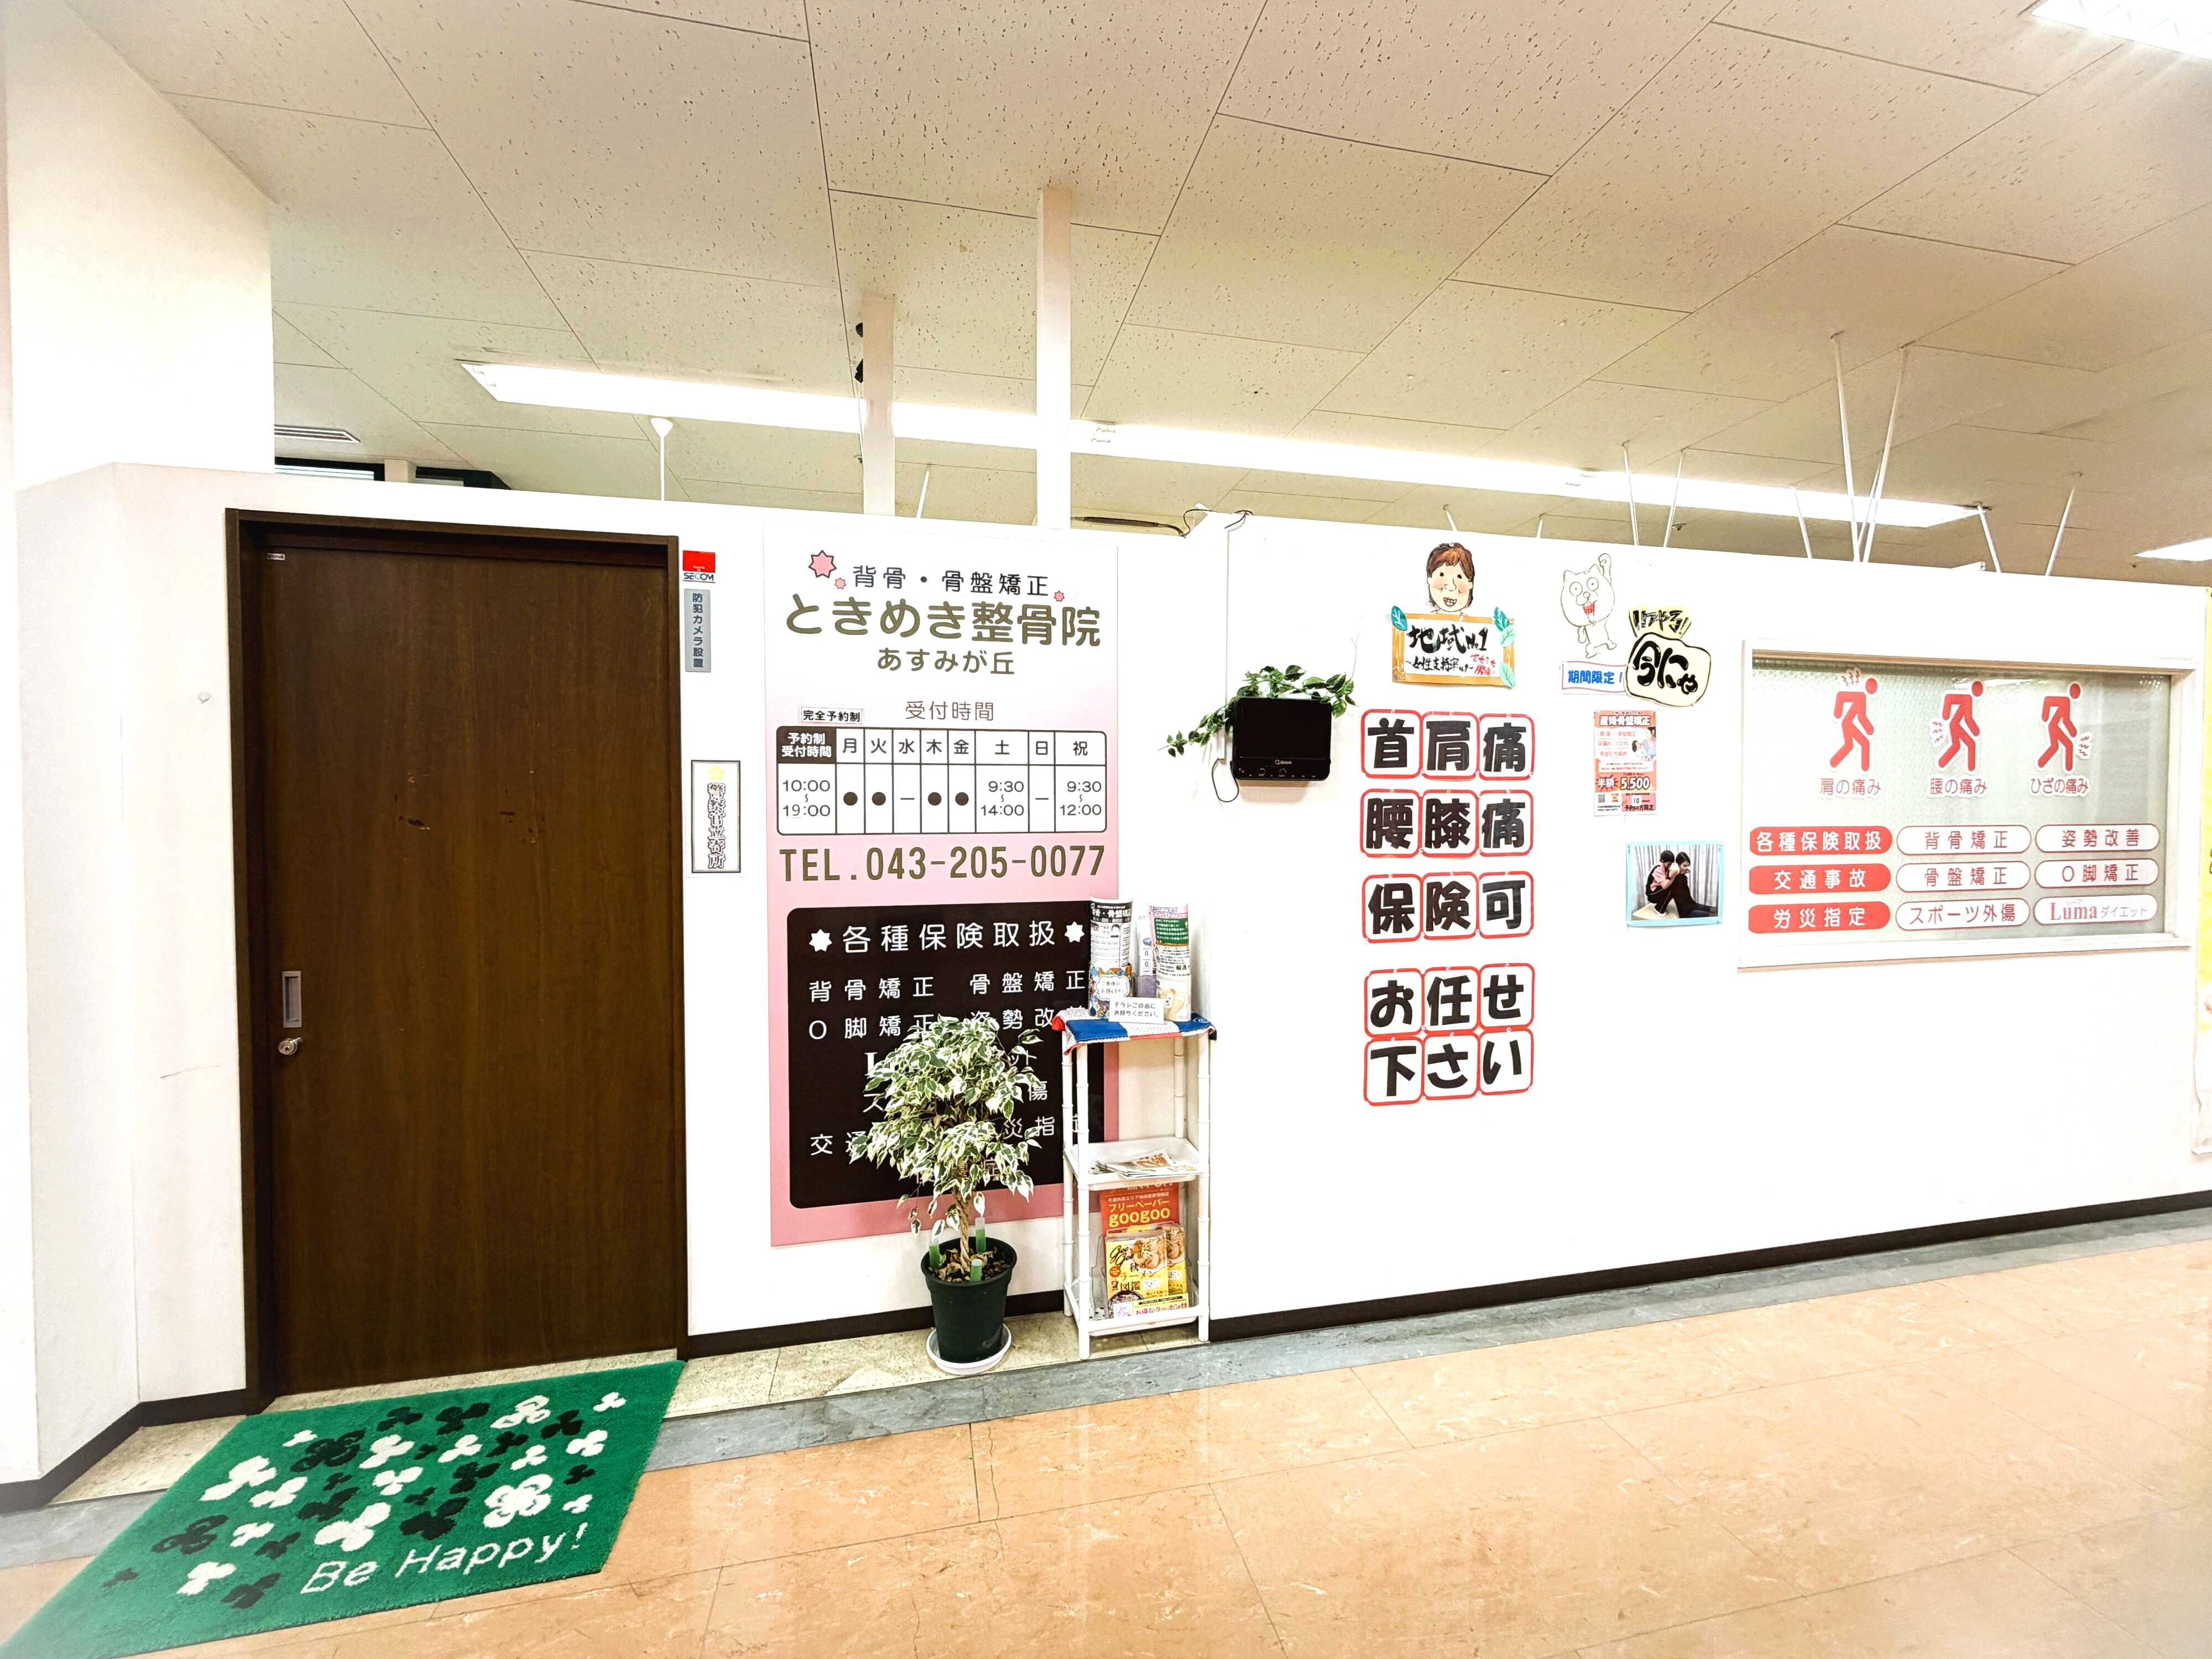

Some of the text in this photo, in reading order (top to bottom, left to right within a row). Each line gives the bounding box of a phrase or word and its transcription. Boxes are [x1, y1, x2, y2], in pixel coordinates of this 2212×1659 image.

[684, 572, 714, 581] SECOM
[852, 565, 1049, 597] 背骨・骨盤矯正
[786, 593, 1101, 647] ときめき整骨院
[692, 593, 704, 668] 防犯カメラ設置
[877, 647, 1015, 675] あすみが丘
[1567, 670, 1623, 685] 期間限定!
[803, 710, 860, 723] 完全予約制
[905, 701, 994, 721] 受付時間
[787, 732, 826, 745] 予約制
[842, 738, 1088, 756] 月 火 水 木 金 土 日 祝
[781, 745, 832, 758] 受付時間
[782, 779, 831, 792] 10:00
[988, 780, 1024, 792] 9:30
[1067, 781, 1102, 792] 9:30
[1820, 778, 1881, 796] 肩の痛み
[1929, 778, 1987, 795] 腰の痛み
[2031, 777, 2089, 795] ひざの痛み
[782, 804, 831, 817] 19:00
[980, 804, 1024, 816] 14:00
[1060, 804, 1102, 816] 12:00
[1365, 797, 1526, 849] 腰膝痛
[1756, 830, 1881, 851] 各種保険取扱
[1924, 830, 2008, 850] 背骨矯正
[2062, 828, 2140, 848] 姿勢改善
[1774, 868, 1866, 890] 交通事故
[1924, 867, 2007, 887] 骨盤矯正
[2062, 863, 2140, 883] O脚矯正
[1368, 880, 1526, 935] 保険可
[1772, 906, 1866, 928] 労災指定
[1910, 901, 2016, 924] スポーツ外傷
[2049, 902, 2147, 920] Luma ダイエット
[842, 920, 1055, 953] 各種保険取扱
[809, 970, 1086, 1003] 背骨矯正 骨盤矯正
[1370, 974, 1525, 1028] お任せ
[808, 1014, 933, 1040] O脚矯正
[1370, 1039, 1522, 1097] 下さい
[1108, 1198, 1170, 1213] フリーペーパー
[1109, 1208, 1171, 1228] googoo
[1120, 1271, 1156, 1281] ラーメン
[300, 1521, 588, 1595] Be Happy!
